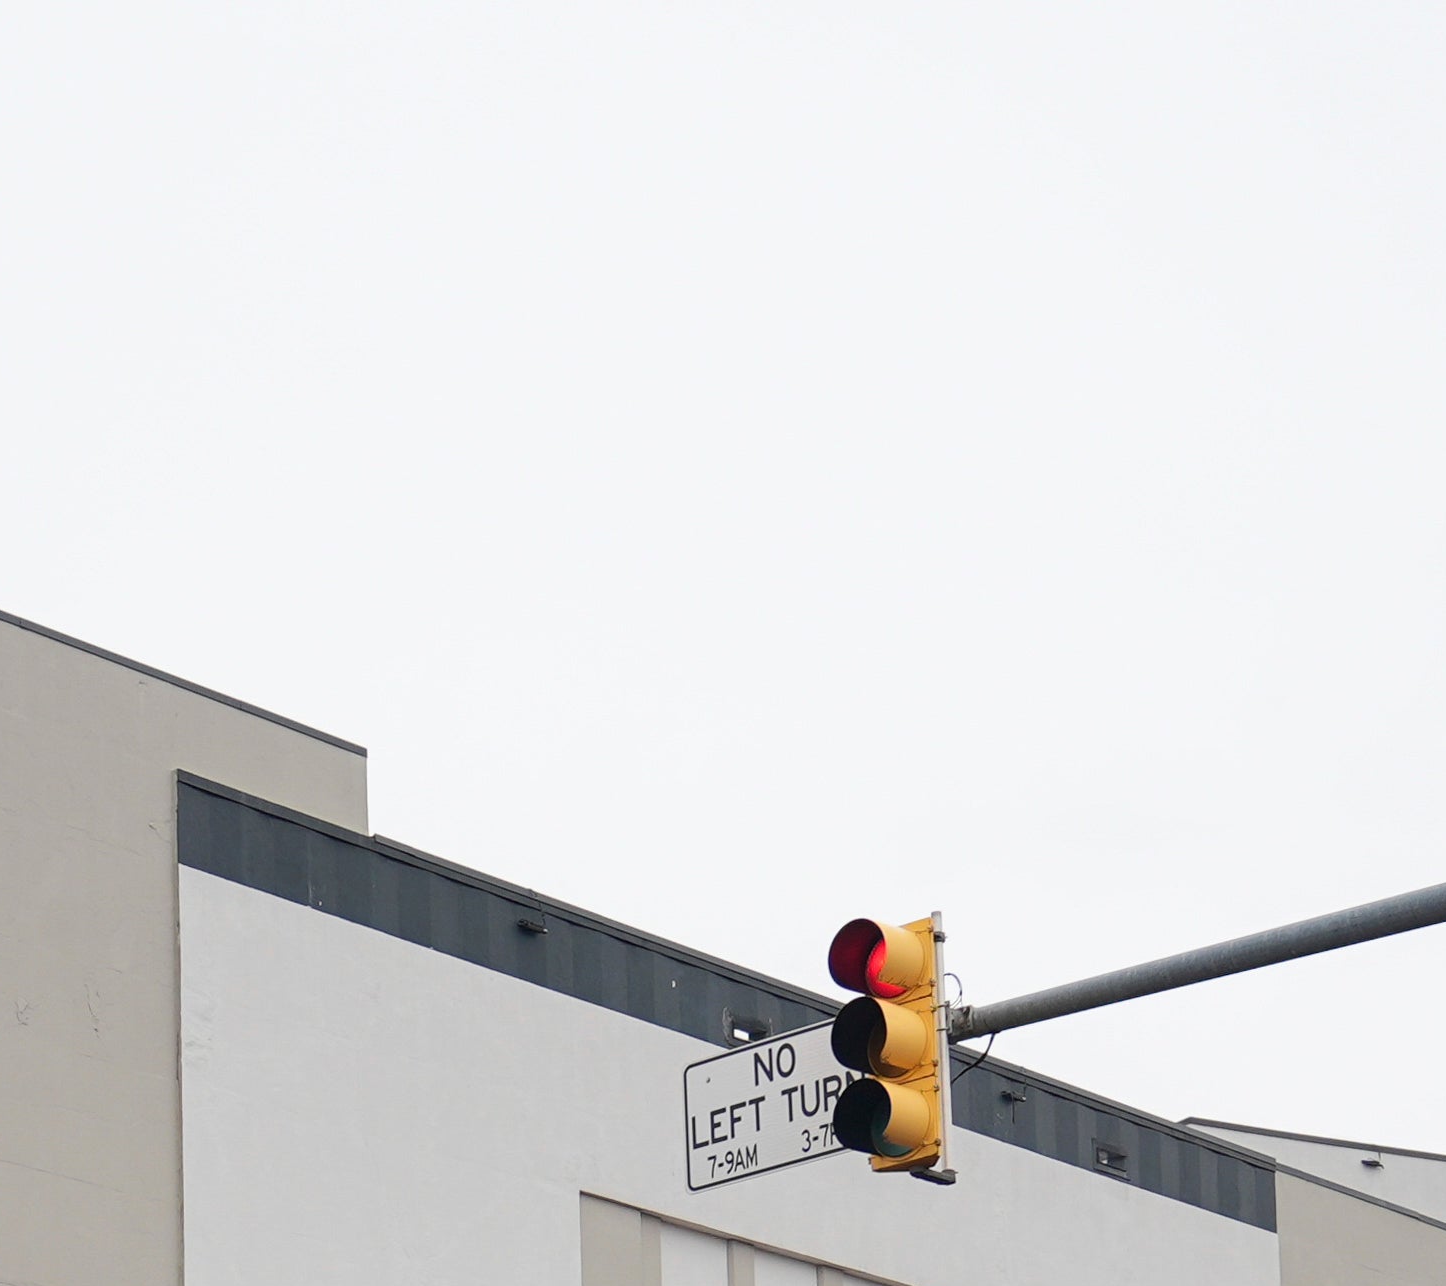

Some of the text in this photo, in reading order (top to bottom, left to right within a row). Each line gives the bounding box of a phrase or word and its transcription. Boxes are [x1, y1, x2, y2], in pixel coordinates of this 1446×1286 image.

[753, 1042, 796, 1087] NO
[691, 1070, 866, 1150] LEFT TUR
[801, 1121, 836, 1152] 3-7P
[707, 1143, 758, 1179] 7-9AM
